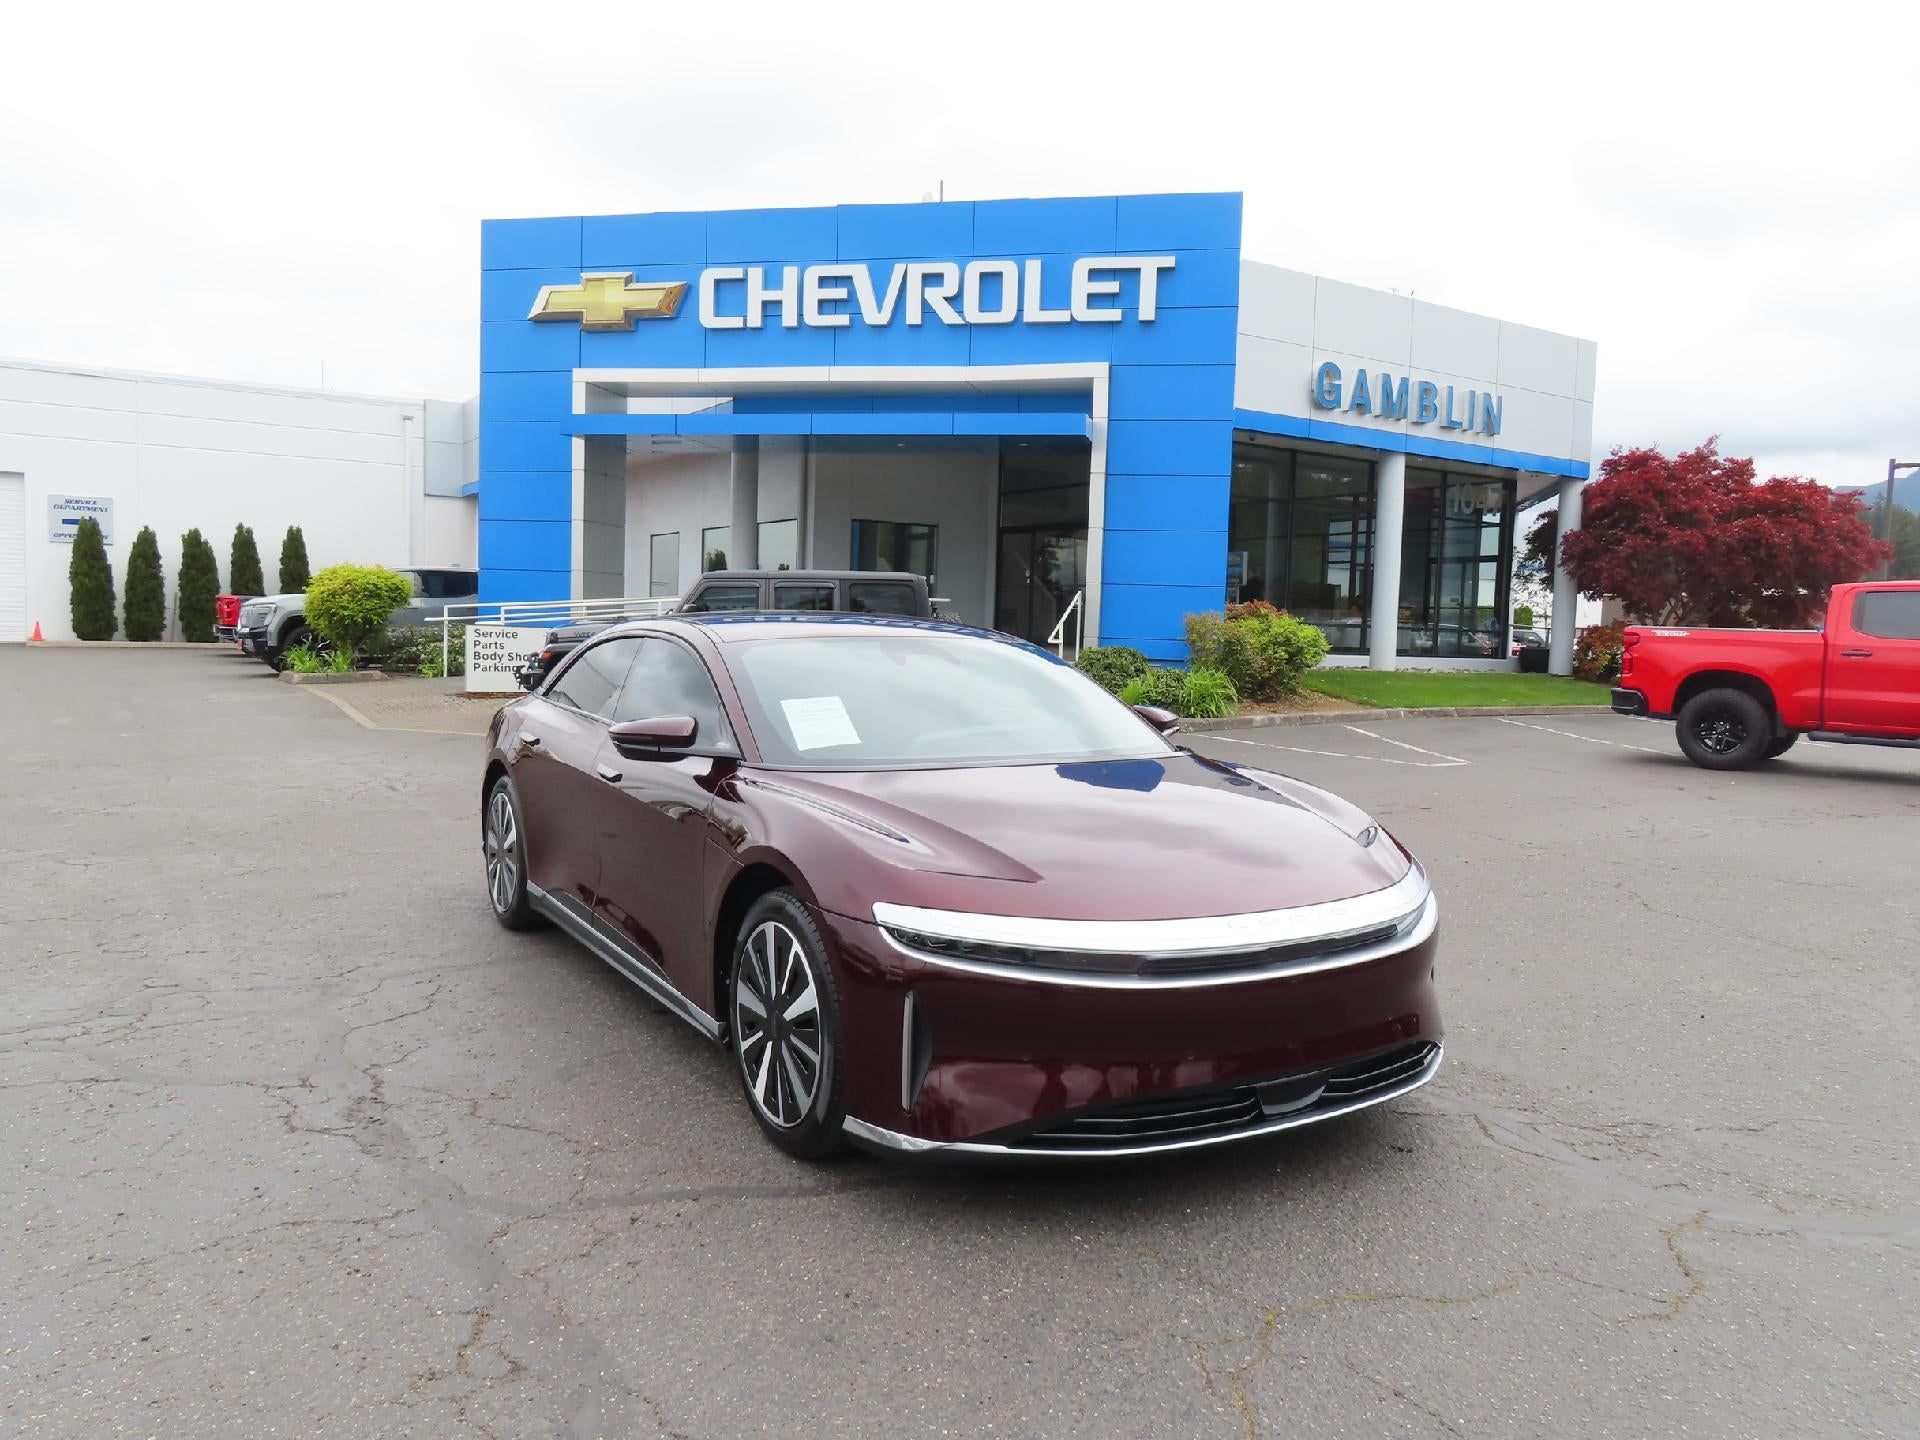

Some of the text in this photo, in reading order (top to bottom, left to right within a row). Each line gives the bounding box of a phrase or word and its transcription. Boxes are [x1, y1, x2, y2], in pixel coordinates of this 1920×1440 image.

[699, 255, 1176, 328] CHEVROLET
[1313, 361, 1503, 436] GAMBLIN
[64, 498, 98, 506] SERVICE
[53, 503, 108, 513] DEPARTMENT
[473, 628, 519, 639] Service
[473, 640, 505, 650] Parts
[473, 651, 532, 663] Body Sho
